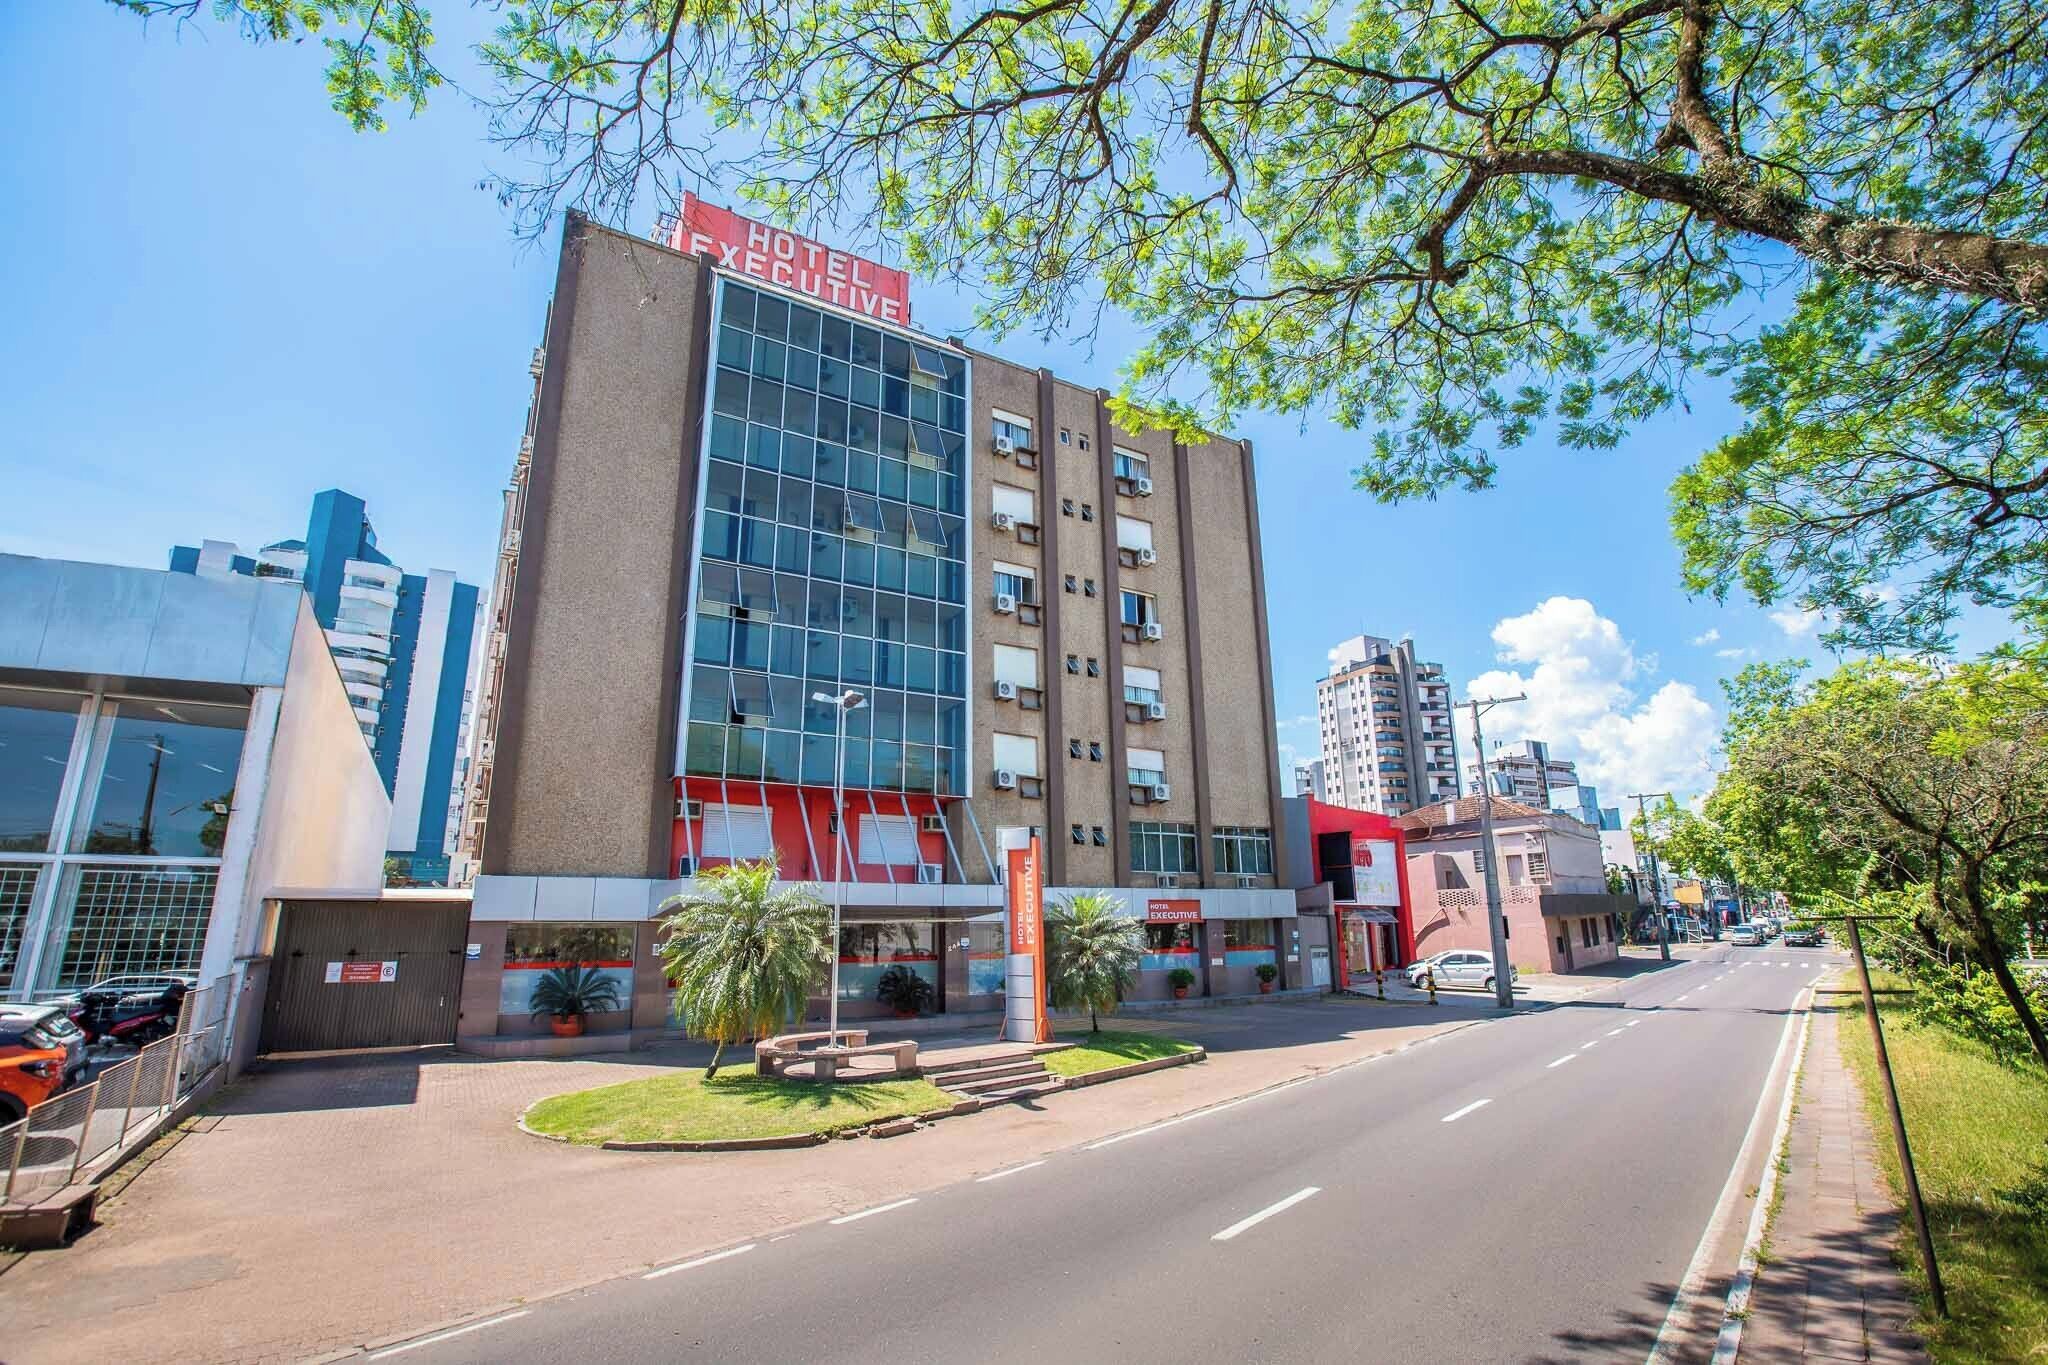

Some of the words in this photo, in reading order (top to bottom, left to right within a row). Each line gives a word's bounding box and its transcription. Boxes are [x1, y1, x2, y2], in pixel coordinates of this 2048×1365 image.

[690, 232, 900, 322] EXECUTIVE
[748, 223, 872, 288] HOTEL
[1024, 856, 1035, 945] EXECUTIVE
[1151, 911, 1198, 919] EXECUTIVE
